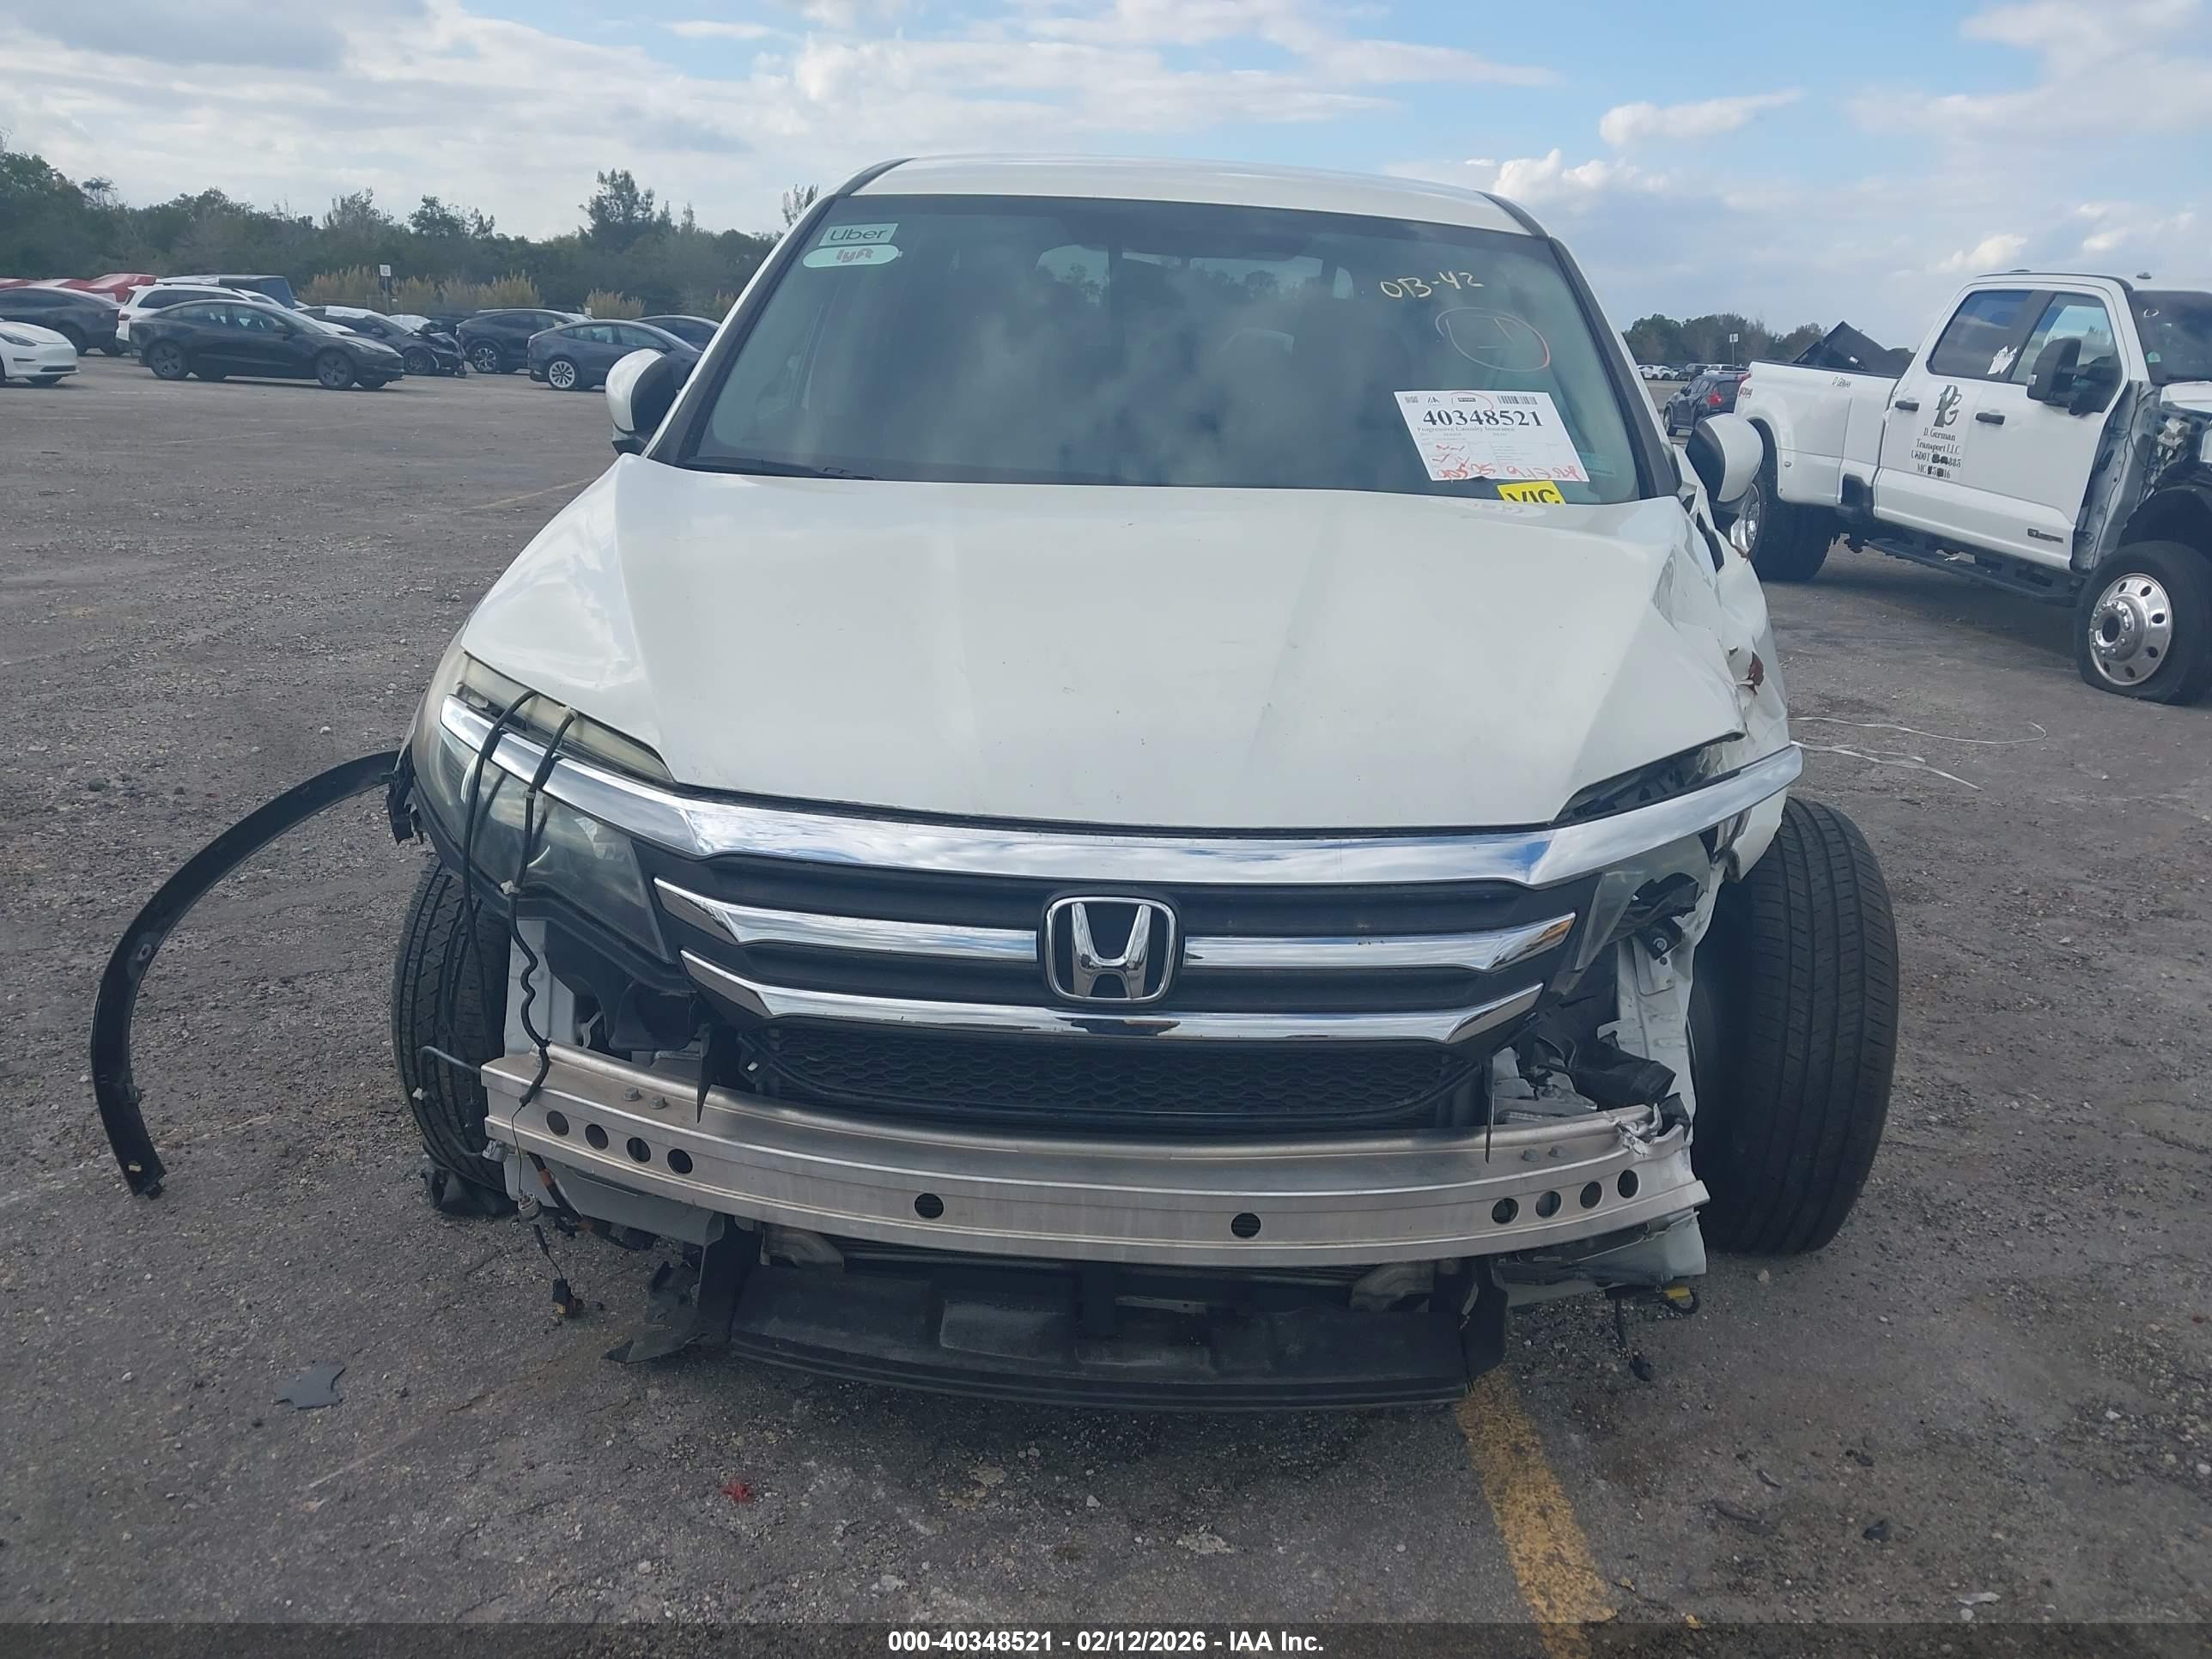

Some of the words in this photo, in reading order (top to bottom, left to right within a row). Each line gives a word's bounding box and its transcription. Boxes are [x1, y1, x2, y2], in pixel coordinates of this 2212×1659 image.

[830, 228, 887, 241] Uber
[836, 247, 874, 263] lyft
[1423, 409, 1544, 427] 40348521
